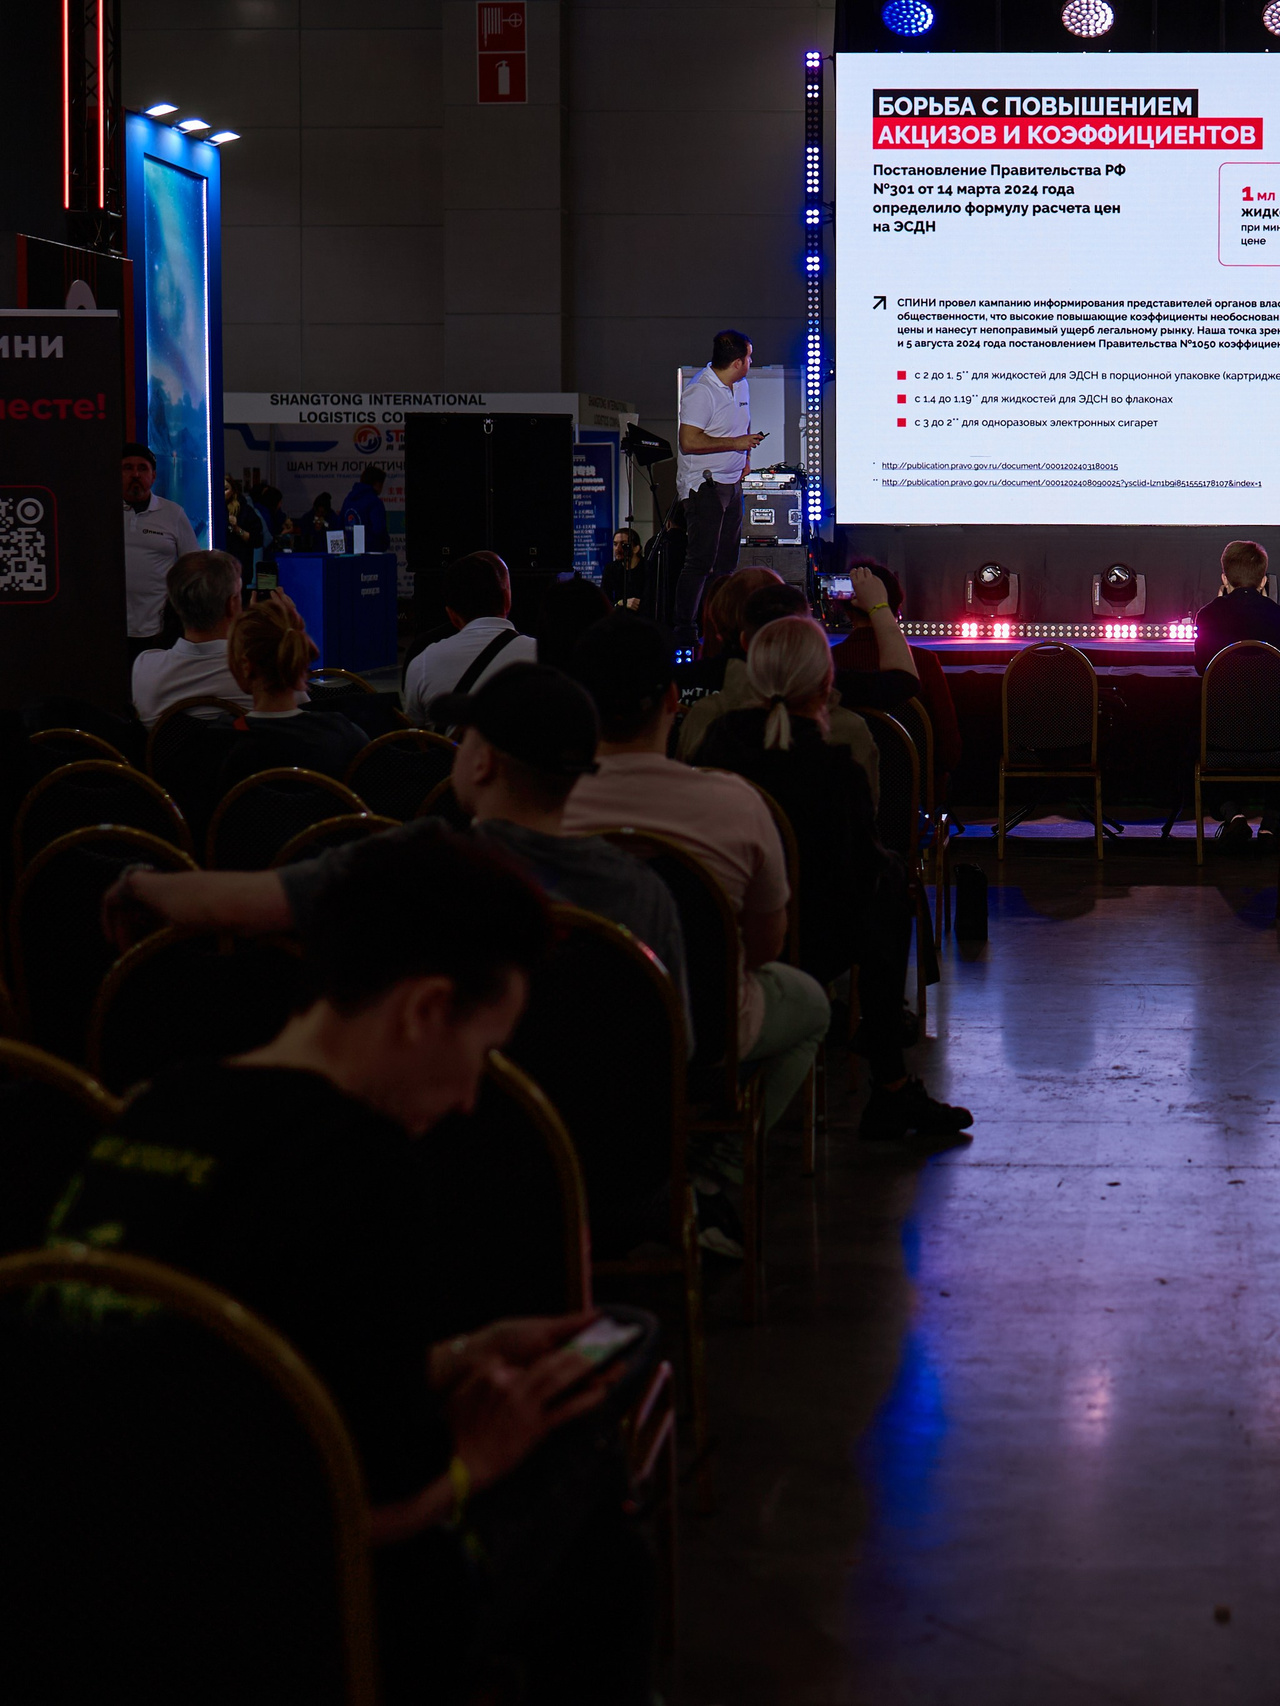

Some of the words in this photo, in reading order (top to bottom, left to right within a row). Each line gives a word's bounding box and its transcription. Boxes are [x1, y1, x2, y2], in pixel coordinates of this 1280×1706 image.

[878, 96, 977, 116] БОРЬБА
[981, 96, 999, 116] С
[1004, 96, 1192, 116] ПОВЫШЕНИЕМ
[877, 125, 997, 149] АКЦИЗОВ
[1003, 125, 1021, 145] И
[1027, 123, 1256, 149] КОЭФФИЦИЕНТОВ
[873, 163, 988, 176] Постановление
[990, 163, 1102, 179] Правительства
[1105, 163, 1127, 177] РФ
[917, 185, 935, 195] от
[937, 184, 954, 197] 14
[956, 185, 1001, 198] марта
[1004, 184, 1039, 197] 2024
[1042, 185, 1075, 197] года
[1241, 185, 1255, 202] 1
[1256, 191, 1276, 202] мл
[872, 204, 962, 217] определило
[964, 201, 1030, 217] формулу
[1032, 204, 1091, 217] расчета
[1094, 204, 1121, 216] цен
[872, 222, 891, 233] на
[893, 220, 936, 235] ЭСДН
[1240, 224, 1261, 234] при
[1240, 237, 1267, 247] цене
[896, 297, 937, 308] СПИНИ
[938, 299, 977, 310] провел
[978, 299, 1032, 308] кампанию
[1033, 297, 1125, 310] информирования
[1126, 298, 1213, 310] представителей
[1214, 300, 1258, 310] органов
[896, 311, 988, 322] общественности,
[989, 313, 1008, 321] что
[1009, 313, 1055, 321] высокие
[1056, 313, 1128, 323] повышающие
[1129, 311, 1208, 324] коэффициенты
[897, 326, 925, 336] цены
[935, 326, 978, 337] нанесут
[979, 325, 1058, 337] непоправимый
[1060, 325, 1096, 337] ущерб
[1096, 327, 1159, 337] легальному
[1160, 327, 1195, 337] рынку.
[1196, 325, 1226, 335] Наша
[1227, 327, 1258, 335] точка
[914, 340, 955, 350] августа
[956, 339, 981, 349] 2024
[983, 340, 1007, 349] года
[1008, 340, 1096, 348] постановлением
[1098, 338, 1178, 351] Правительства
[930, 371, 945, 381] до
[970, 372, 989, 381] для
[991, 370, 1047, 381] жидкостей
[1048, 372, 1067, 381] для
[1068, 370, 1099, 382] ЭДСН
[1109, 370, 1172, 382] порционной
[1174, 372, 1221, 383] упаковке
[270, 393, 363, 406] SHANGTONG
[368, 393, 487, 406] INTERNATIONAL
[923, 395, 937, 405] 1.4
[937, 395, 952, 405] до
[980, 395, 999, 405] для
[1000, 394, 1057, 405] жидкостей
[1058, 396, 1077, 405] для
[1078, 394, 1109, 406] ЭДСН
[1110, 396, 1124, 404] во
[1124, 394, 1174, 406] флаконах
[299, 411, 377, 424] LOGISTICS
[382, 411, 406, 424] CO
[930, 419, 945, 428] до
[961, 419, 980, 428] для
[981, 419, 1048, 429] одноразовых
[1049, 419, 1116, 429] электронных
[1117, 419, 1159, 430] сигарет
[287, 461, 313, 472] ШАН
[316, 461, 338, 472] ТУН
[342, 461, 405, 472] ЛОГИСТИЧ
